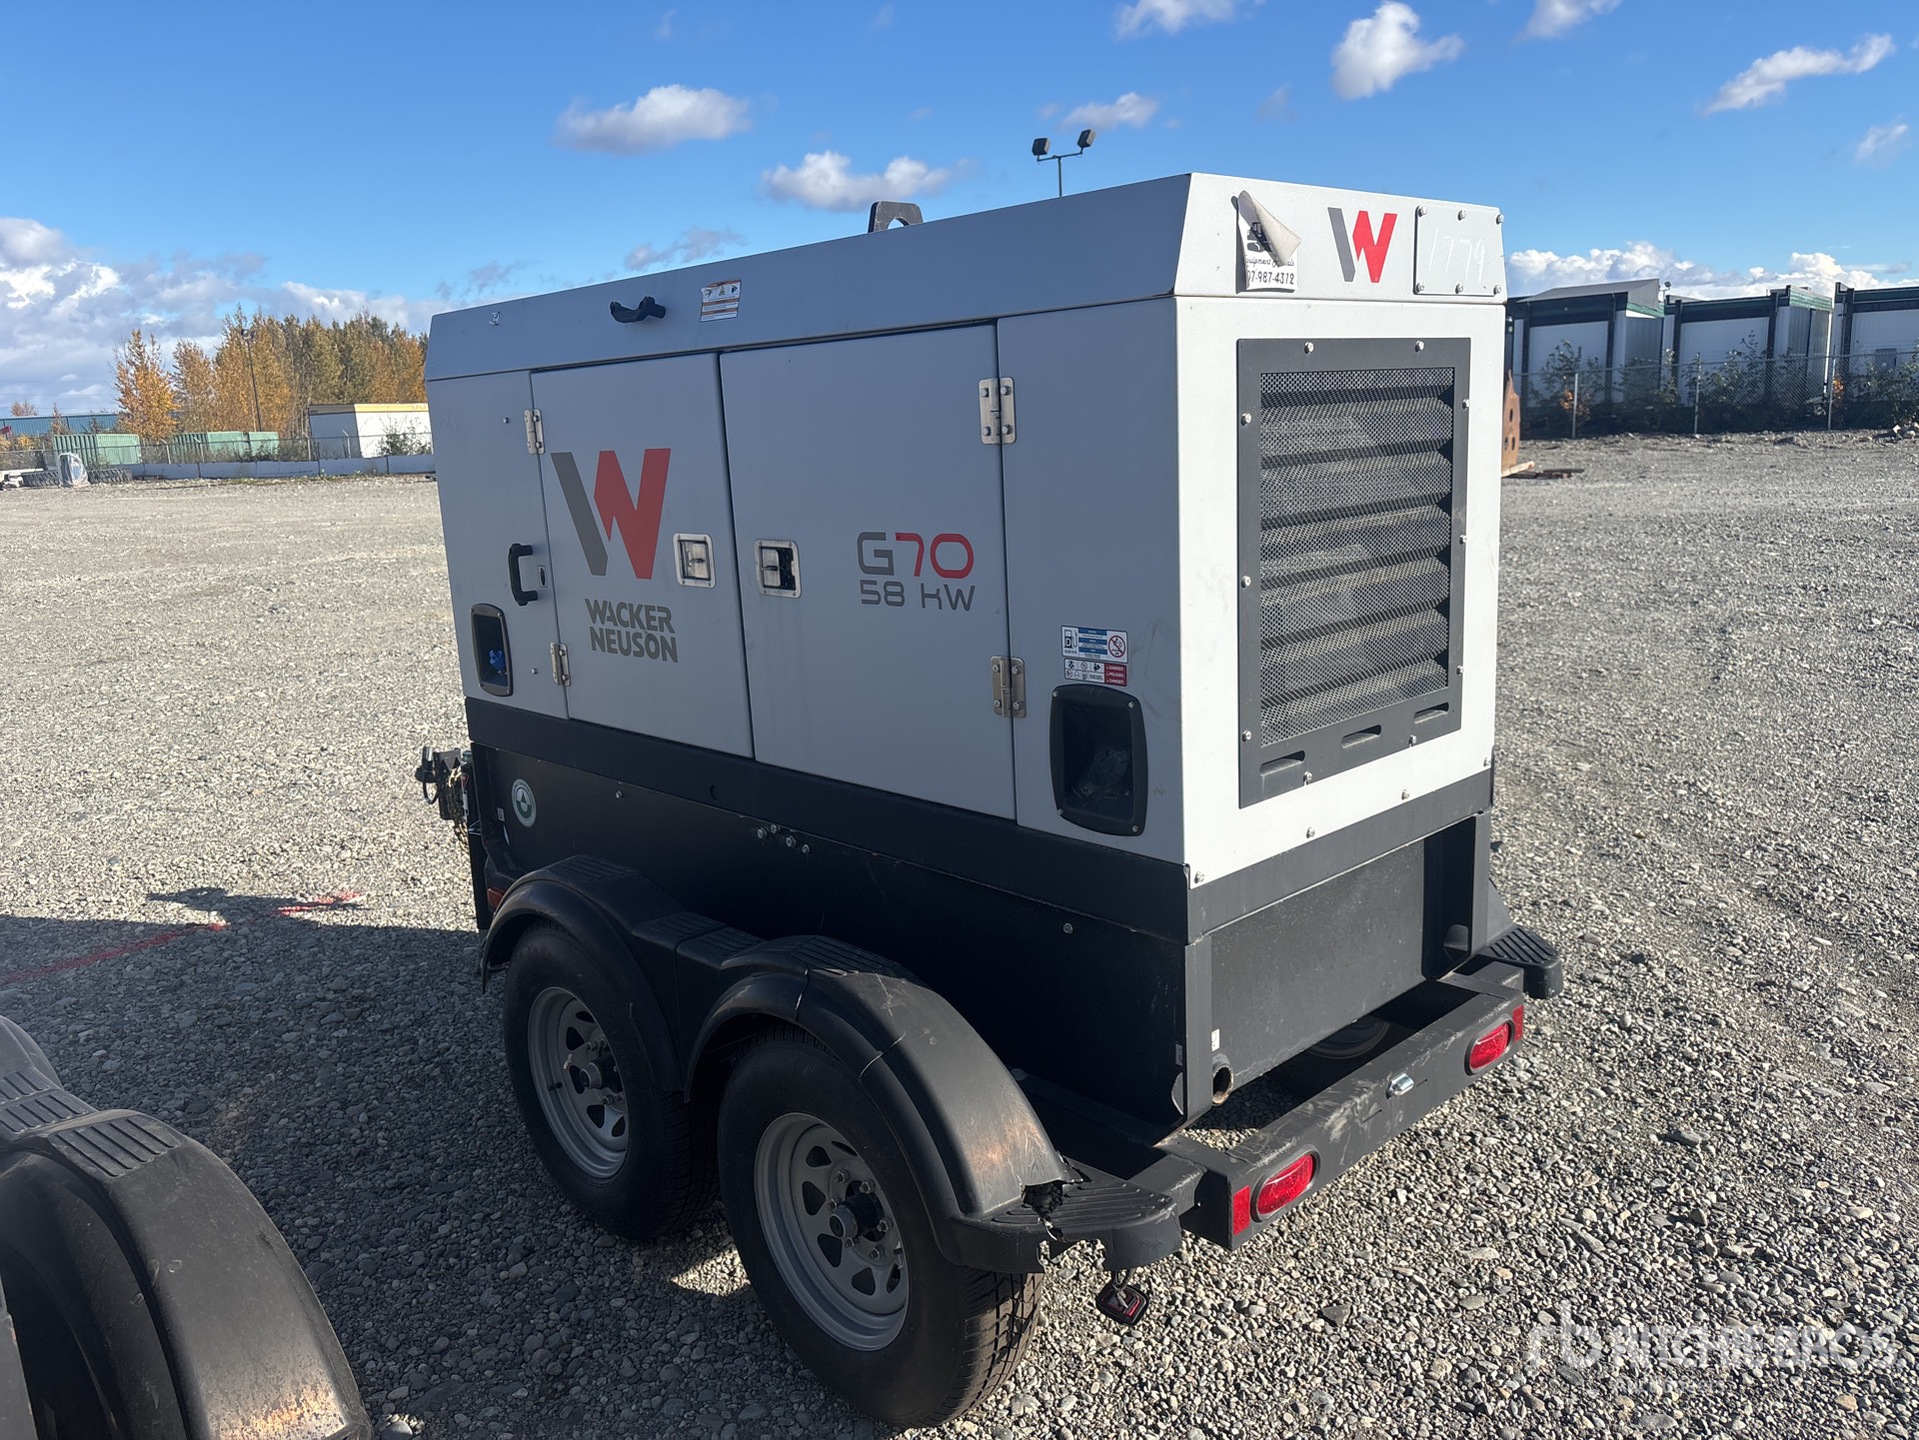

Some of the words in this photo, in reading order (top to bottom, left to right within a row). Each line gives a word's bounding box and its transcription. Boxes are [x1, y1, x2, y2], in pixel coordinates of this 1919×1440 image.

[857, 531, 975, 579] G70
[860, 579, 905, 607] 58
[584, 598, 675, 634] WACKER
[589, 626, 678, 663] NEUSON
